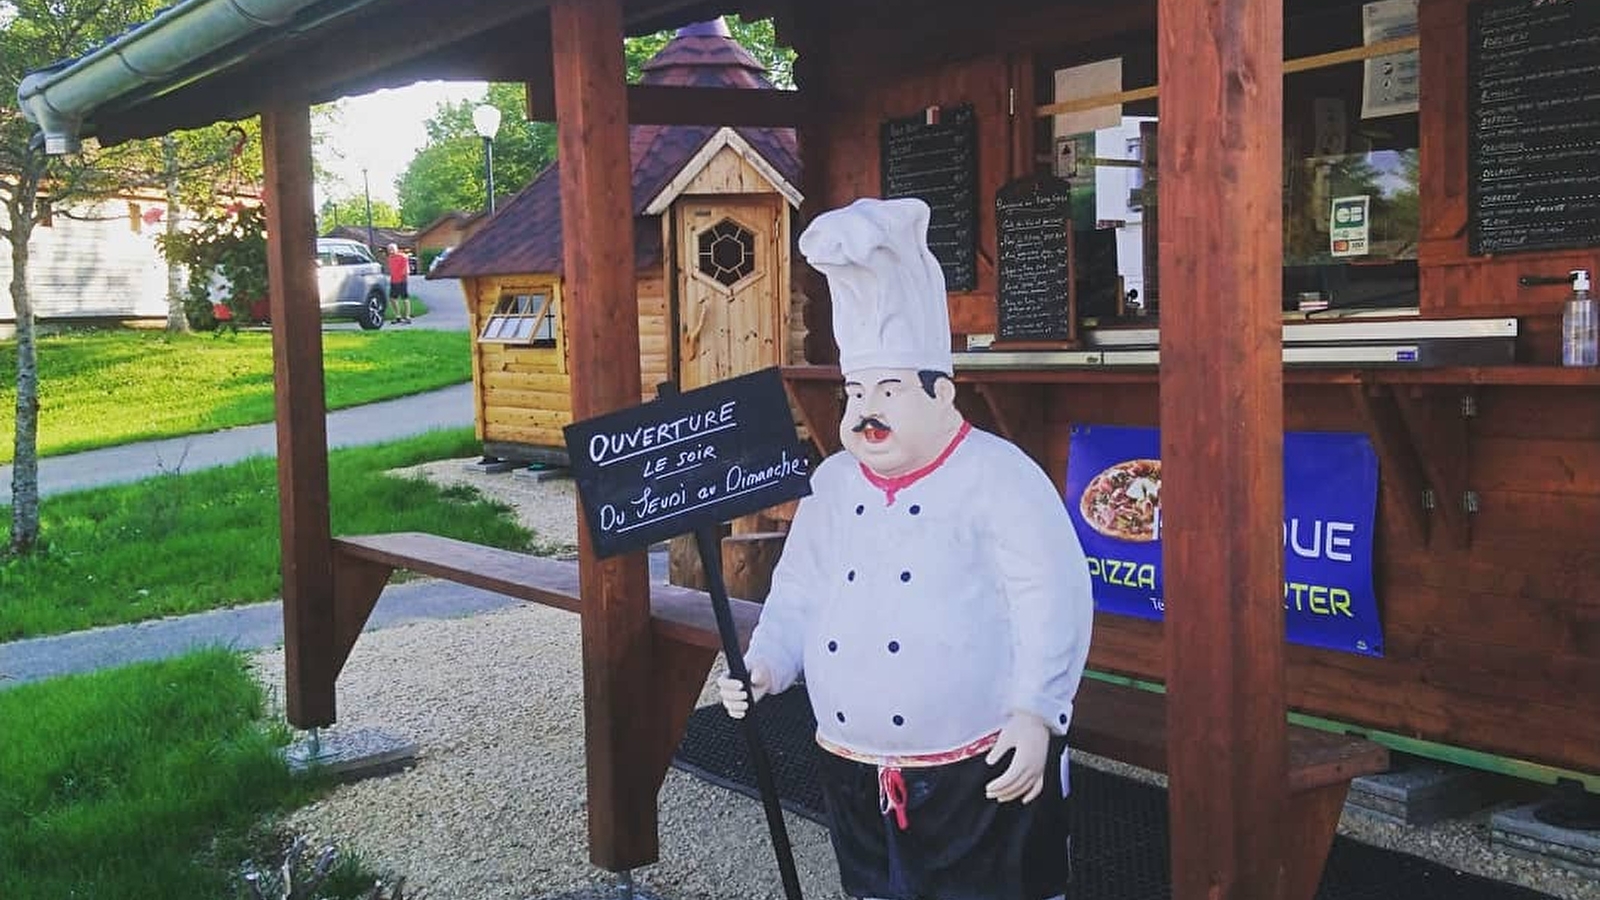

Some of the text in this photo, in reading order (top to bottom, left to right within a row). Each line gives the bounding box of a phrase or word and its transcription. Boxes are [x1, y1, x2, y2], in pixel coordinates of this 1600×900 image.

[589, 401, 736, 462] OUVERTURE
[643, 457, 667, 478] LE
[1283, 518, 1355, 562] UE
[1087, 556, 1354, 617] PIZZA TER
